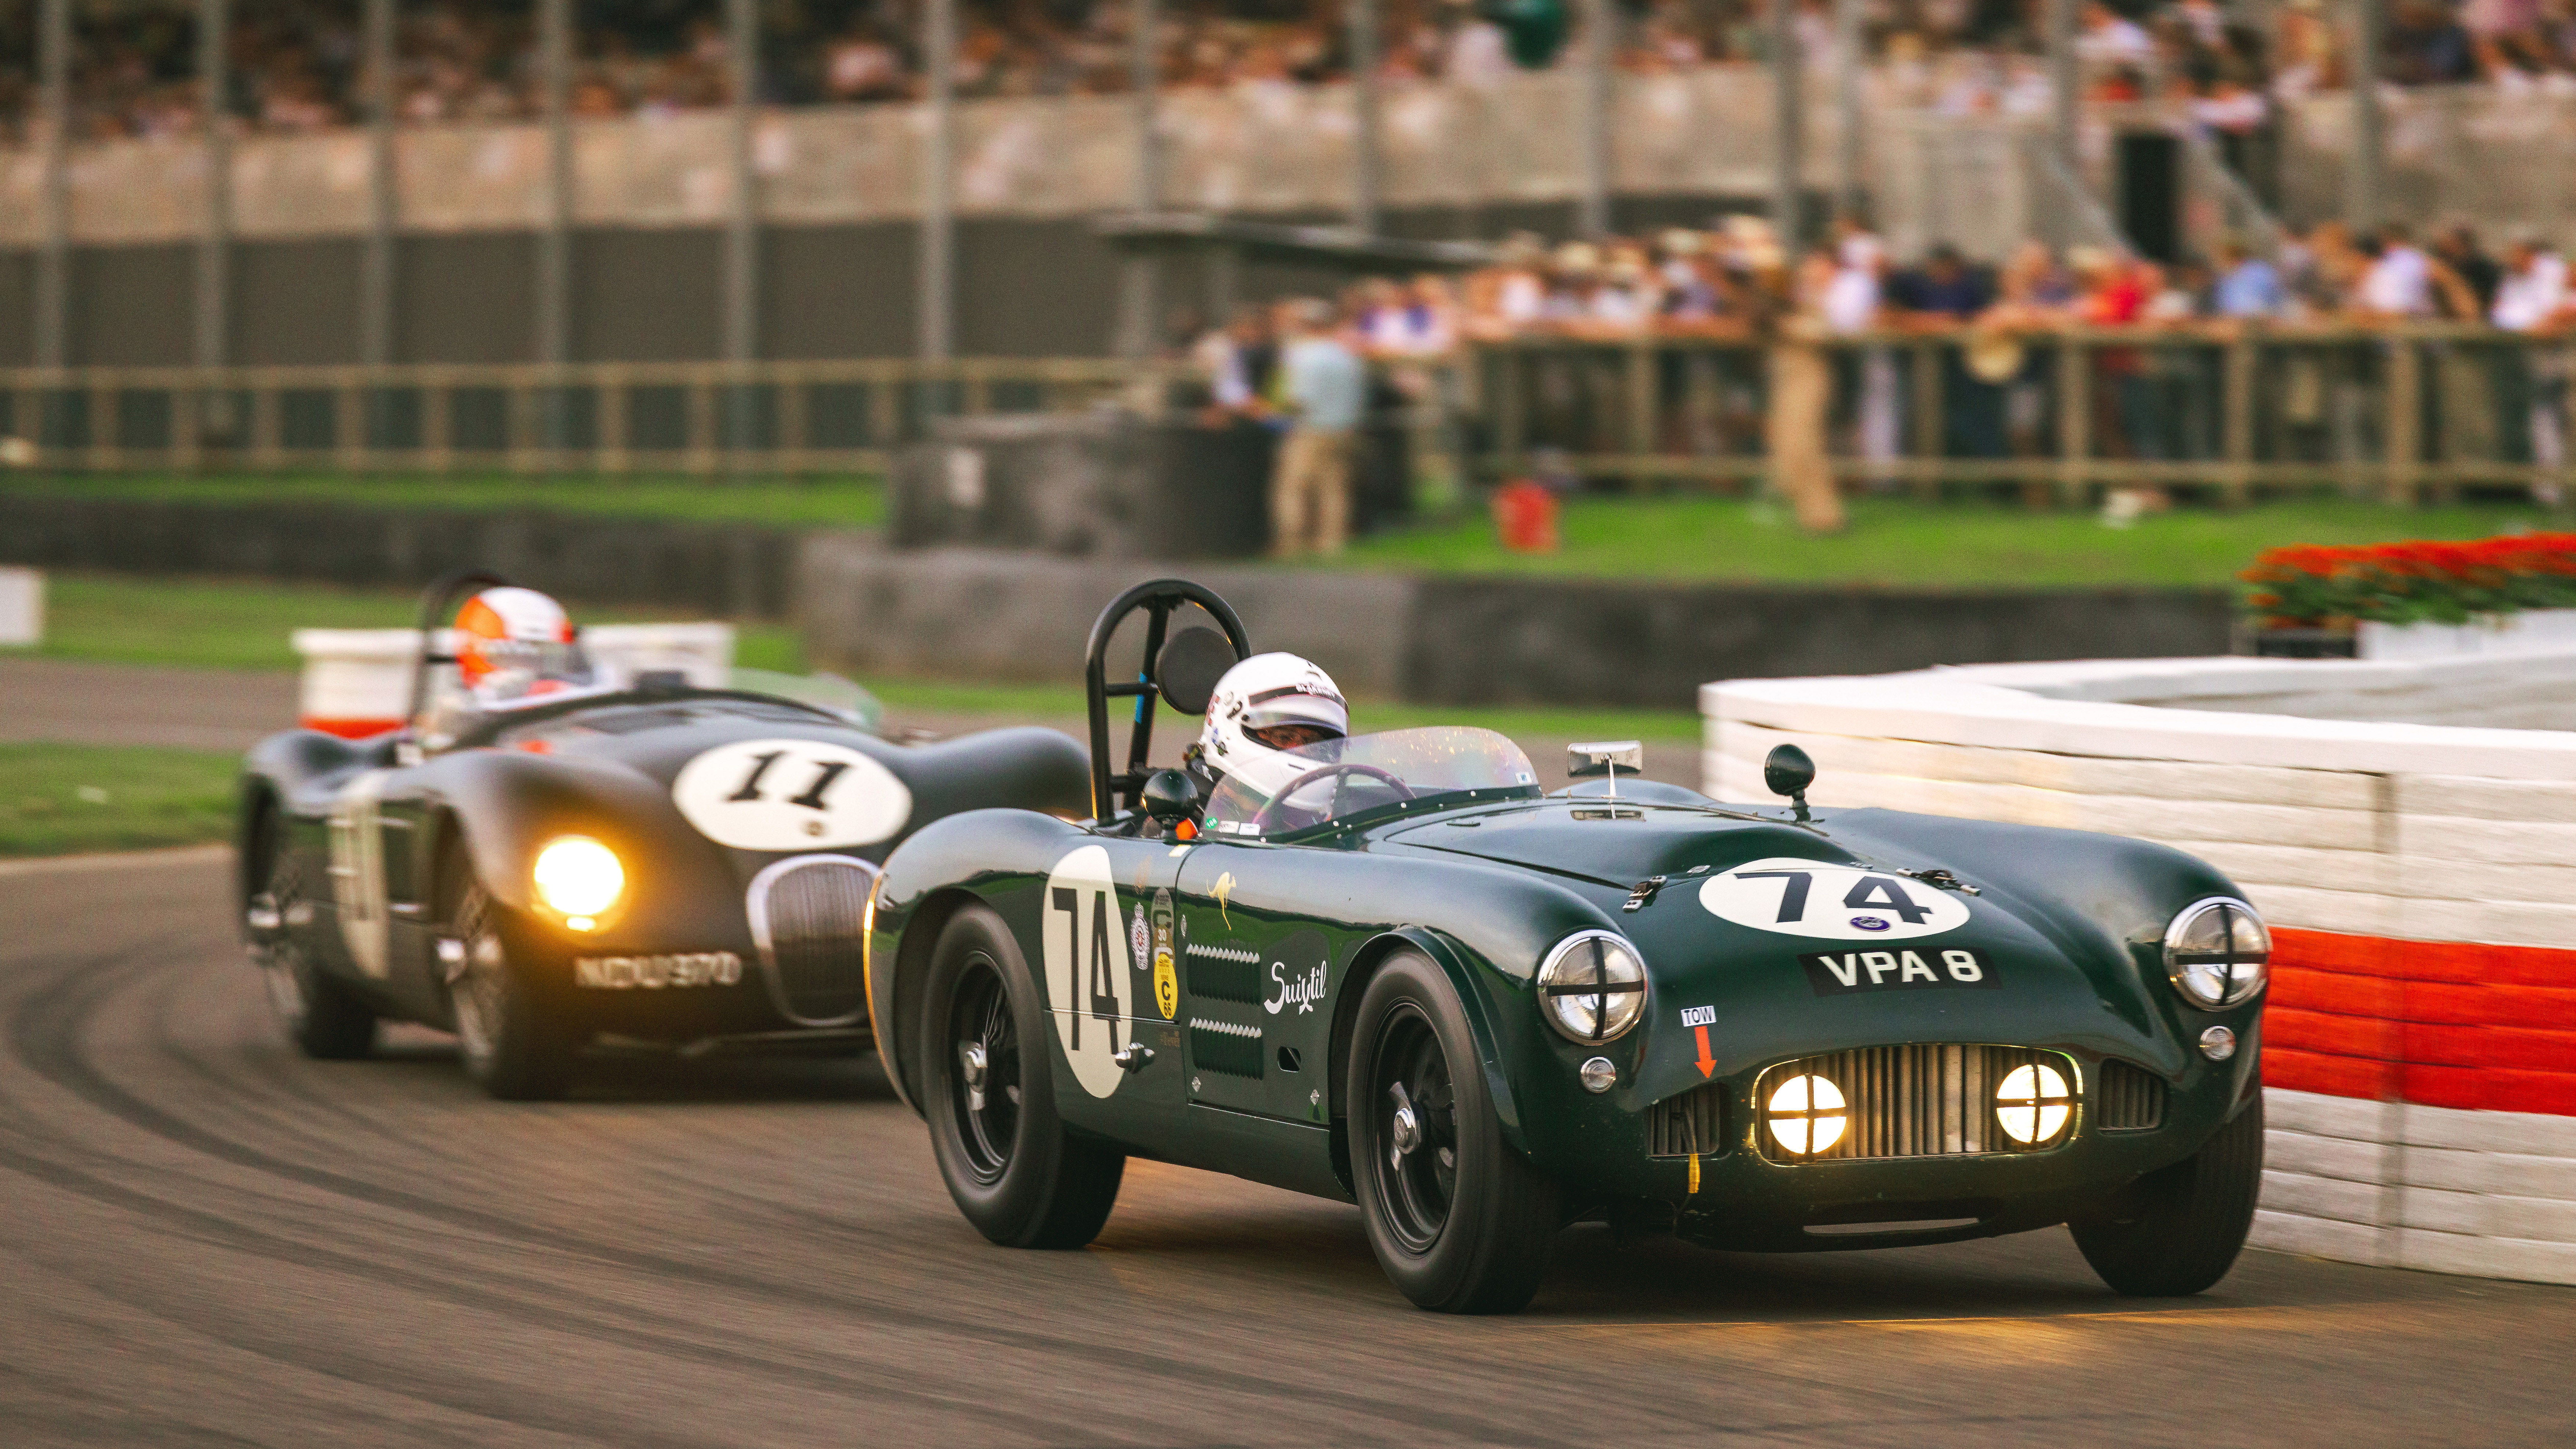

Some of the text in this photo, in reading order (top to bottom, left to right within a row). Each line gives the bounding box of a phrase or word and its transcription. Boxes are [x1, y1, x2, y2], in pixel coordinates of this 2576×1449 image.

[722, 749, 852, 811] 11
[1733, 872, 1934, 925] 74
[1052, 887, 1120, 1055] 74
[1162, 981, 1170, 1001] C
[1264, 960, 1327, 1015] Suixtil
[1817, 950, 1983, 986] VPA 8
[1684, 1007, 1712, 1024] TOW
